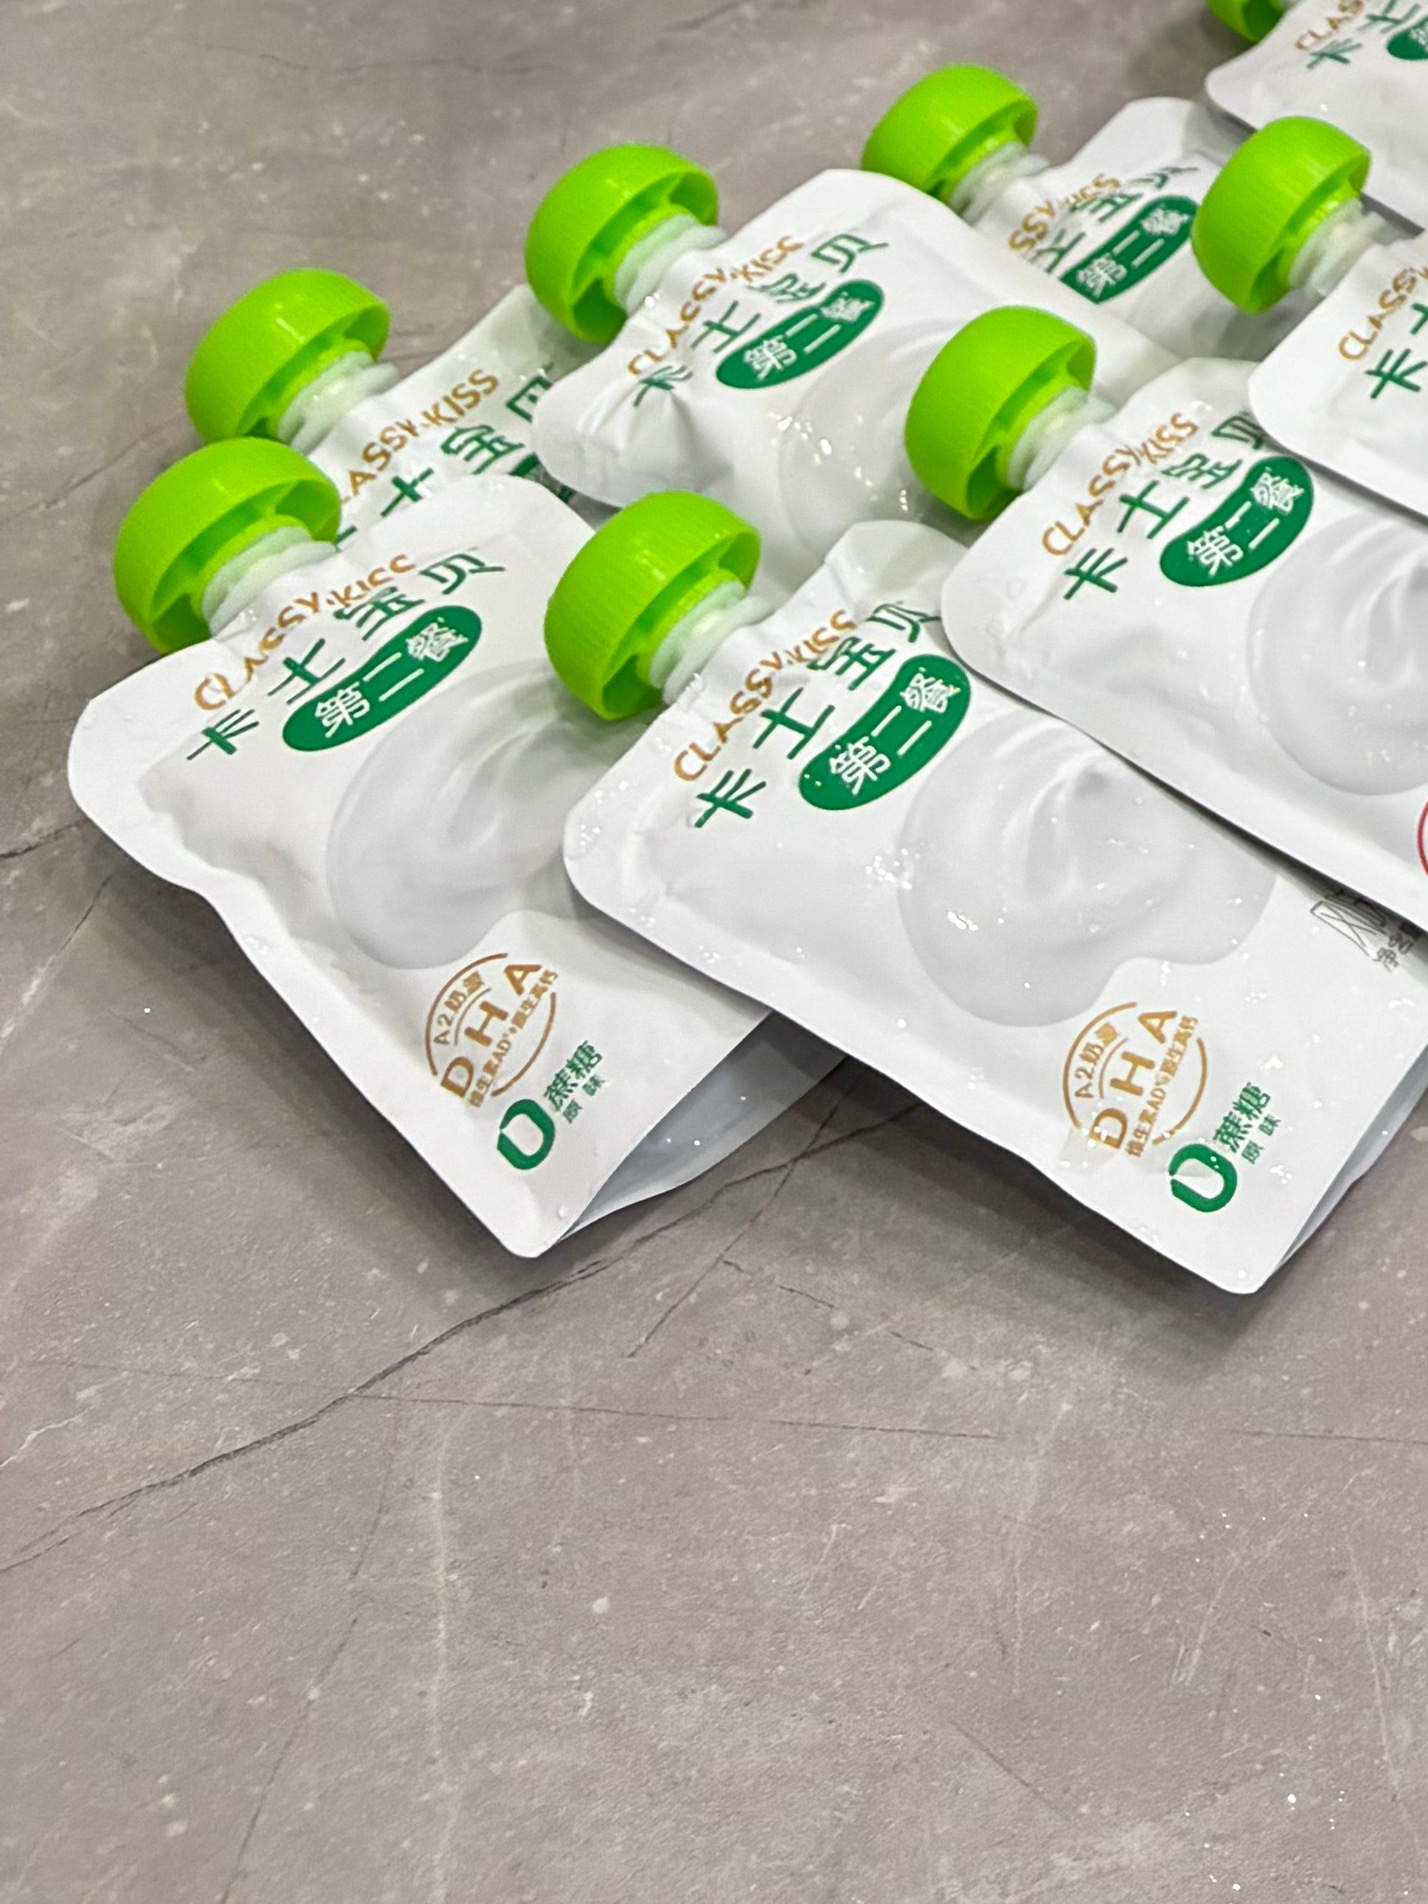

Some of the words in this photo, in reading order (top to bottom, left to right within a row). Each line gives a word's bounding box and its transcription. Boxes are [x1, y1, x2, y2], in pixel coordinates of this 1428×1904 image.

[1076, 204, 1191, 297] 第二餐
[633, 233, 889, 407] 卡士宝贝
[743, 291, 875, 381] 第二餐
[1064, 413, 1264, 601] 卡士宝贝
[1186, 467, 1306, 579] 第二餐
[186, 551, 506, 761] 卡士宝贝
[314, 617, 470, 739] 第二餐
[694, 602, 942, 829] 卡士宝贝
[828, 666, 961, 796] 第二餐
[440, 963, 543, 1099] DHA
[1087, 1009, 1179, 1151] DHA
